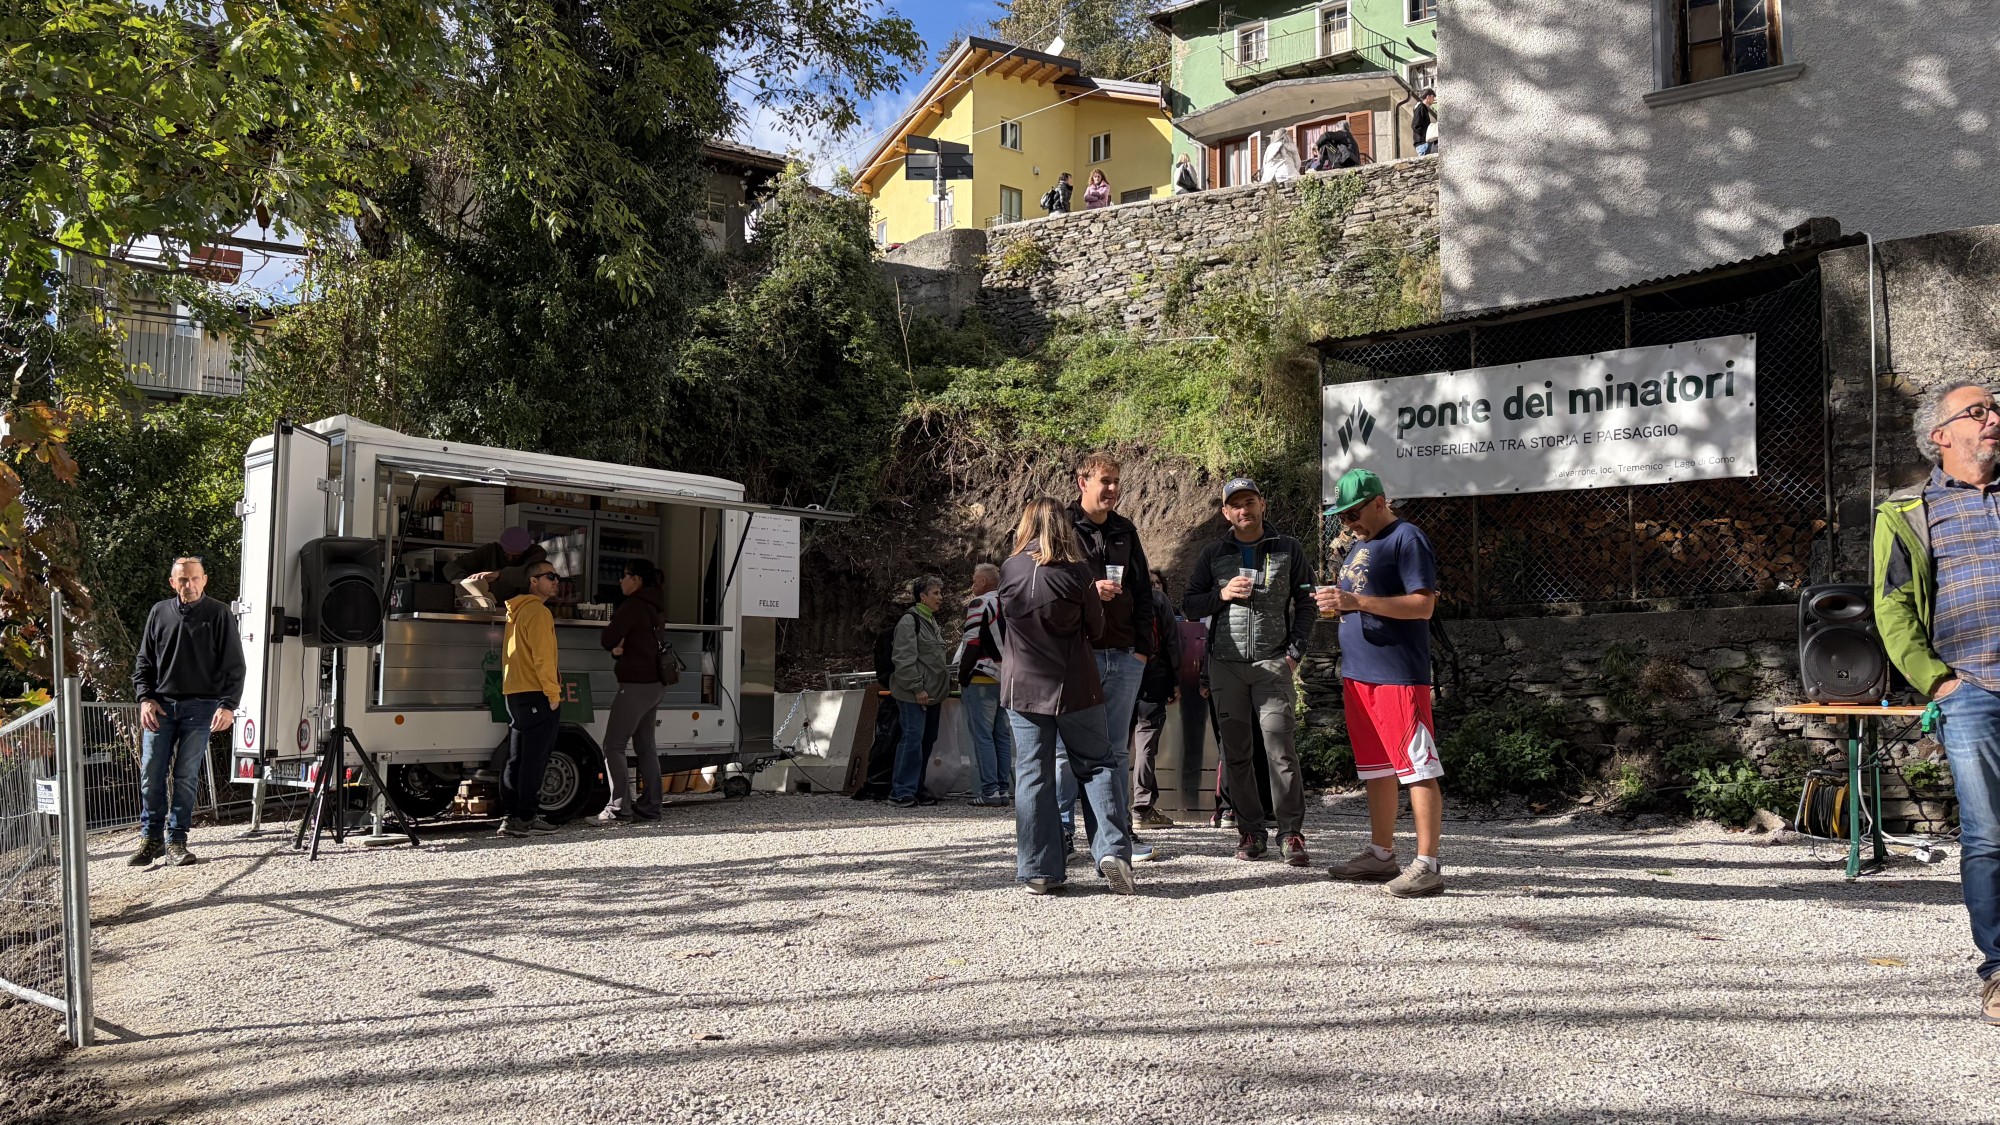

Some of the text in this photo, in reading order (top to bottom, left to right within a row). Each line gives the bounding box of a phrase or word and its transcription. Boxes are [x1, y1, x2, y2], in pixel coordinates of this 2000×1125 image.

[1396, 359, 1735, 440] ponte dei minatori
[1396, 424, 1678, 459] UN'ESPERIENZA TRA STORIA E PAESAGGIO
[1554, 468, 1597, 478] Valvarrone,
[1600, 466, 1615, 474] loc.
[1617, 461, 1663, 473] Tremenico
[1674, 460, 1696, 469] Lago
[1699, 457, 1706, 466] di
[1708, 456, 1736, 465] Como
[758, 599, 780, 608] FELICE
[246, 728, 253, 739] 70
